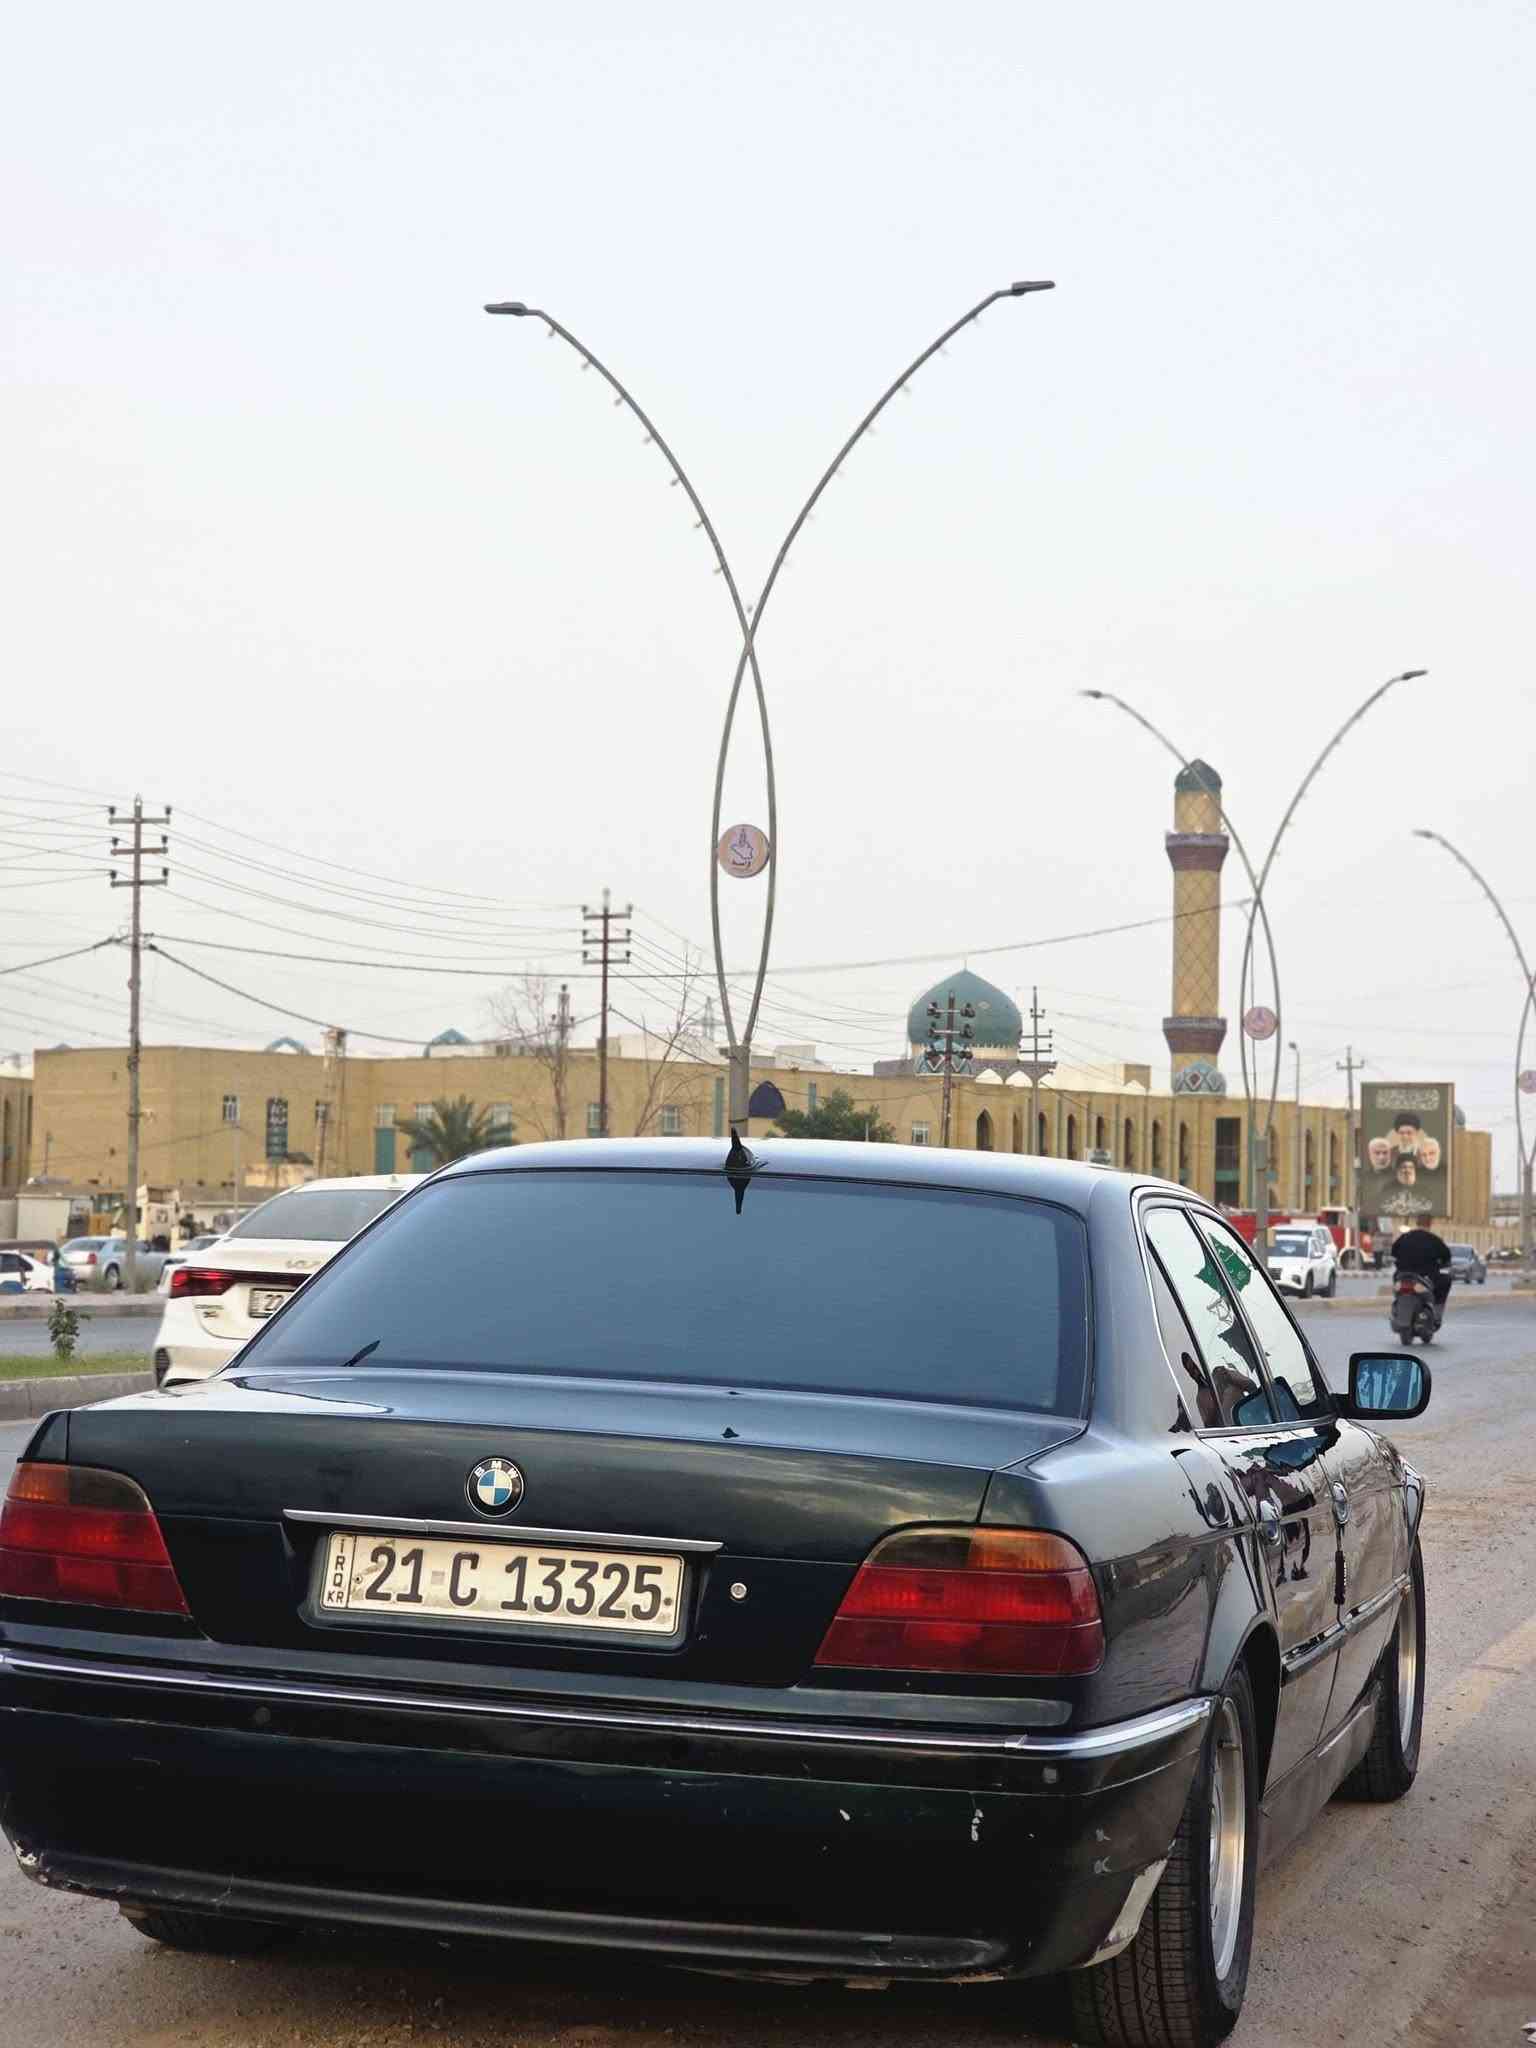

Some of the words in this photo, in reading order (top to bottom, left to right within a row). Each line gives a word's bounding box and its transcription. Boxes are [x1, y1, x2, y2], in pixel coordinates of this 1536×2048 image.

[474, 1460, 519, 1480] BMW
[364, 1546, 425, 1604] 21
[448, 1552, 480, 1607] C
[500, 1555, 663, 1622] 13325
[327, 1590, 344, 1604] KR
